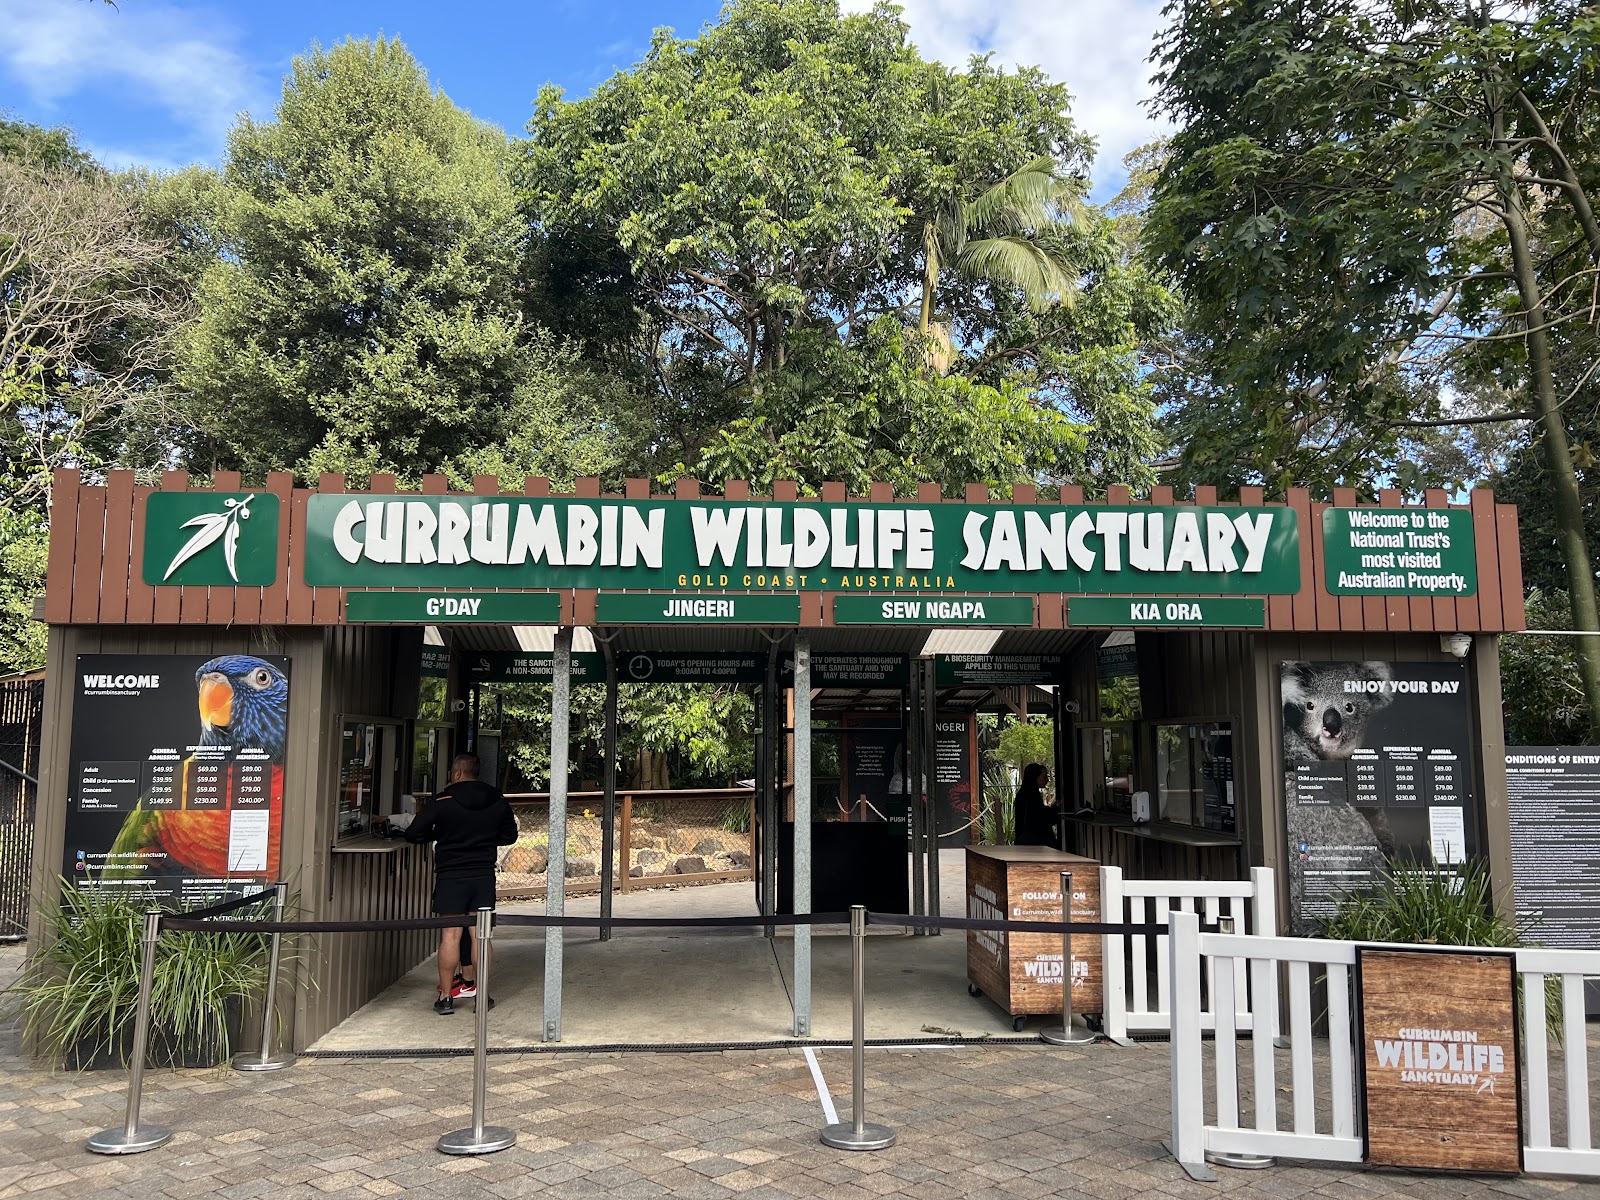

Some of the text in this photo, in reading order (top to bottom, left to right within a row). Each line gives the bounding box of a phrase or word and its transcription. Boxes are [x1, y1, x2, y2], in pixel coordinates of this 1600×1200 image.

[1348, 510, 1449, 529] Welcome to the
[332, 500, 1274, 573] CURRUMBIN WILDLIFE SANCTUARY
[1350, 531, 1451, 550] National Trust's
[1361, 553, 1441, 569] most visited
[678, 574, 956, 589] GOLD COAST AUSTRALIA
[1338, 571, 1467, 592] Australian Property.
[426, 598, 482, 616] G'DAY
[663, 600, 735, 617] JINGERI
[882, 602, 986, 620] SEW NGAPA
[1130, 603, 1203, 621] KIA ORA
[514, 659, 528, 667] THE
[571, 660, 579, 668] IS
[686, 660, 716, 668] OPENING
[717, 660, 741, 668] HOURS
[741, 660, 755, 668] ARE
[858, 657, 902, 665] THROUGHOUT
[951, 655, 994, 663] BIOSECURITY
[506, 667, 511, 675] A
[569, 667, 586, 675] ENUE
[815, 664, 827, 672] THE
[828, 664, 863, 672] SANTUARY
[864, 664, 878, 672] AND
[1003, 663, 1018, 671] THIS
[83, 675, 160, 688] WELCOME
[849, 672, 885, 680] RECORDED
[1343, 680, 1459, 694] ENJOY YOUR DAY
[936, 722, 965, 732] NGERI
[1505, 755, 1600, 764] ONDITIONS OF ENTRY
[1022, 892, 1057, 900] FOLLOW
[1073, 892, 1086, 900] ON
[1398, 1027, 1478, 1043] CURRUMBIN
[1374, 1039, 1505, 1073] WILDLIFE
[1401, 1070, 1479, 1085] SANCTUARY
